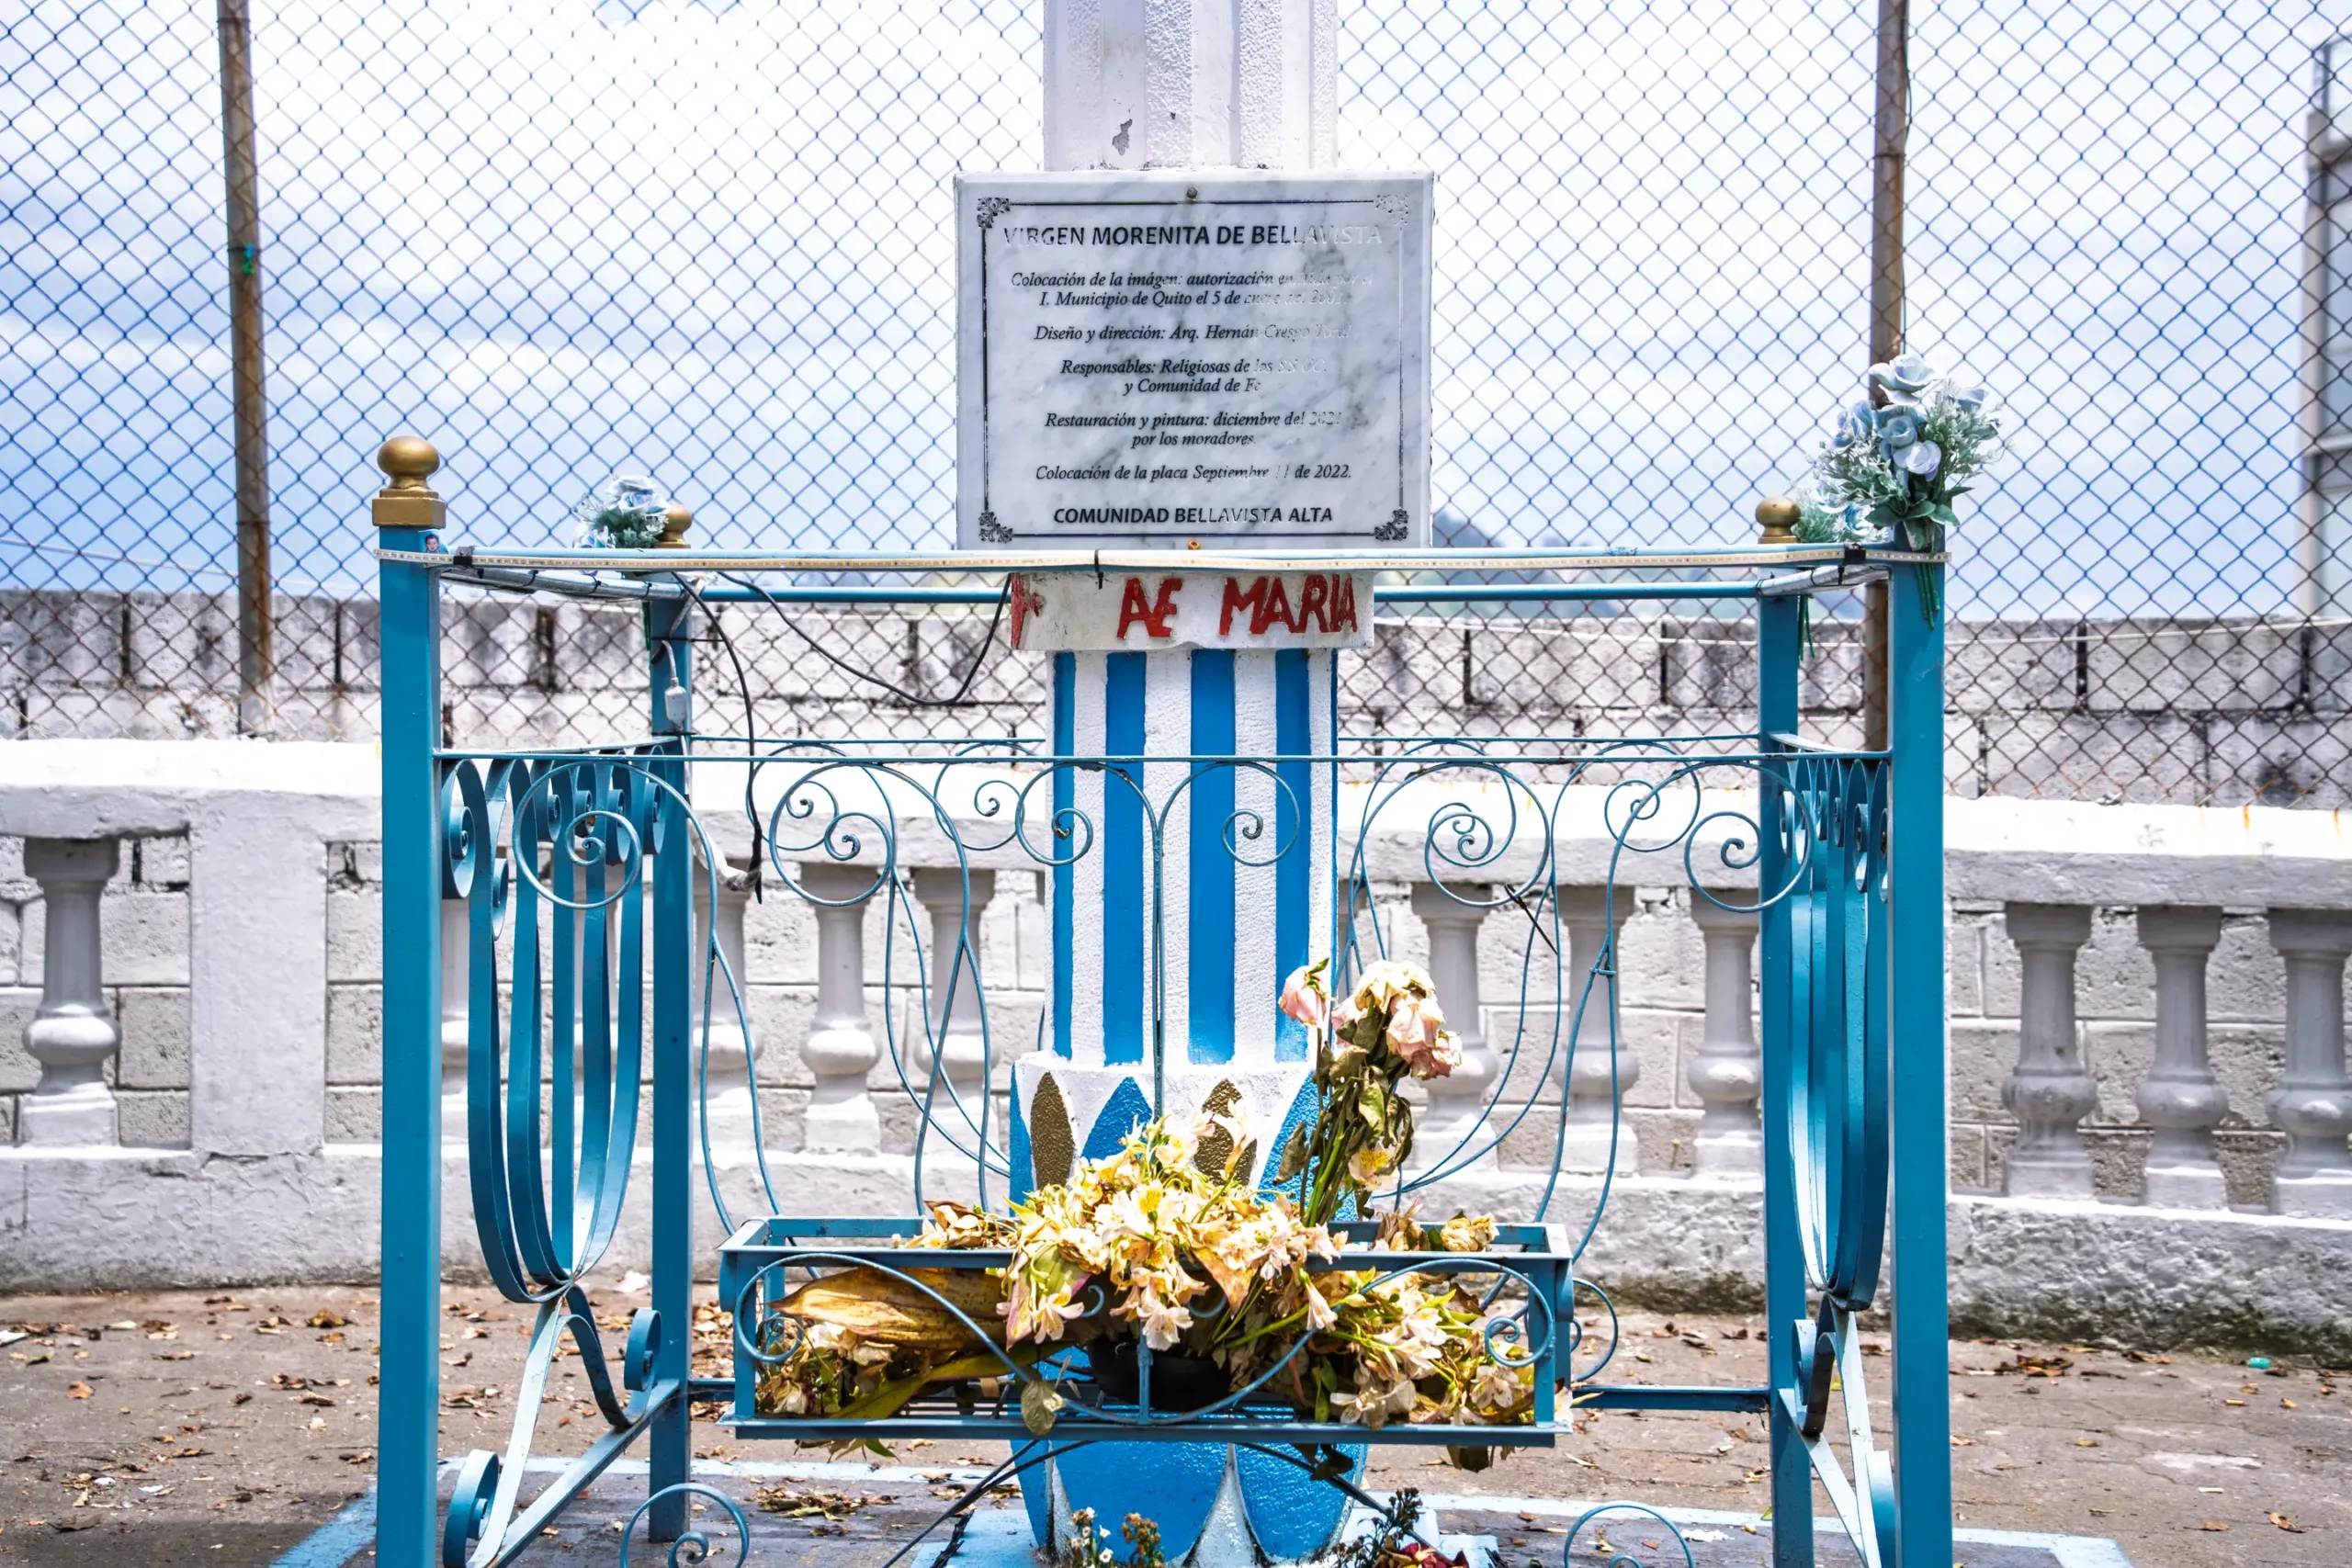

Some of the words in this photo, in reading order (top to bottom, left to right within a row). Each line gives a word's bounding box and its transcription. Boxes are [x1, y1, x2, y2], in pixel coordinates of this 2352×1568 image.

[1003, 227, 1084, 246] VIRGEN
[1091, 226, 1209, 245] MORENITA
[1216, 226, 1244, 244] DE
[1251, 225, 1383, 244] BELLAVISTA
[1011, 272, 1085, 287] Colocación
[1090, 273, 1105, 286] de
[1109, 273, 1122, 286] la
[1126, 272, 1182, 288] imágen:
[1186, 272, 1273, 287] autorización
[1055, 291, 1128, 309] Municipio
[1132, 291, 1148, 305] de
[1152, 291, 1193, 308] Quito
[1196, 290, 1208, 304] el
[1213, 290, 1220, 304] 5
[1225, 290, 1241, 304] de
[1034, 325, 1082, 340] Diseño
[1085, 330, 1096, 344] y
[1099, 325, 1166, 340] dirección:
[1169, 325, 1200, 343] Arq.
[1204, 324, 1259, 340] Hernán
[1264, 324, 1310, 343] Crespo
[1059, 359, 1156, 378] Responsables:
[1159, 358, 1230, 376] Religiosas
[1234, 358, 1250, 373] de
[1122, 382, 1134, 396] y
[1137, 378, 1220, 393] Comunidad
[1224, 378, 1240, 392] de
[1044, 412, 1136, 427] Restauración
[1138, 416, 1149, 430] y
[1150, 413, 1209, 430] pintura:
[1213, 412, 1281, 426] diciembre
[1283, 412, 1306, 425] del
[1130, 436, 1157, 449] por
[1159, 431, 1178, 446] los
[1035, 465, 1111, 480] Colocación
[1114, 466, 1131, 479] de
[1134, 466, 1148, 479] la
[1149, 465, 1188, 483] placa
[1193, 464, 1270, 482] Septiembre
[1295, 464, 1311, 479] de
[1314, 464, 1351, 479] 2022.
[1054, 508, 1170, 524] COMUNIDAD
[1174, 507, 1283, 524] BELLAVISTA
[1287, 507, 1333, 523] ALTA
[1218, 573, 1359, 636] MARIA
